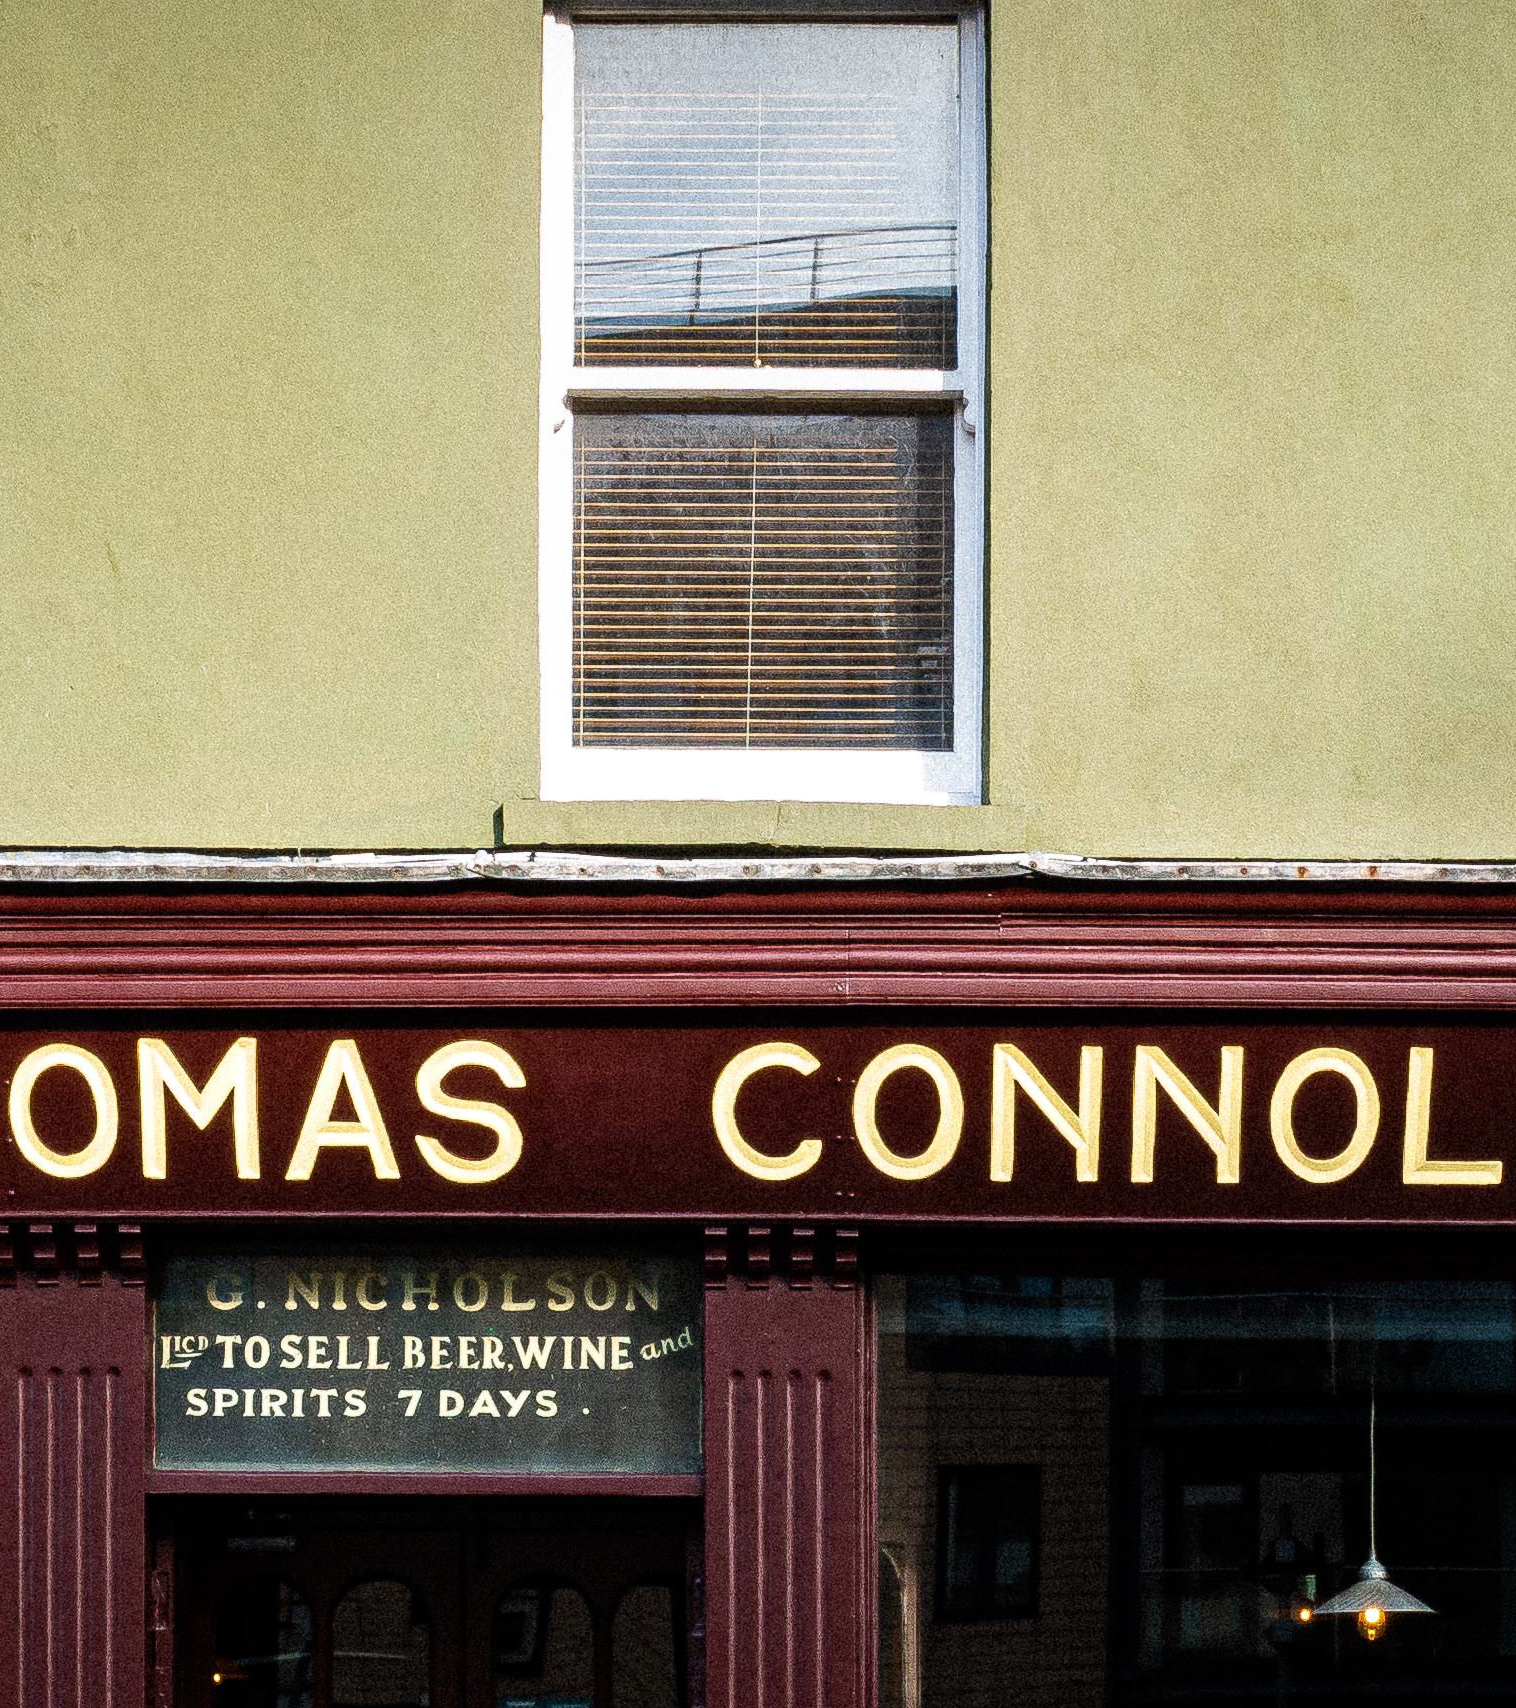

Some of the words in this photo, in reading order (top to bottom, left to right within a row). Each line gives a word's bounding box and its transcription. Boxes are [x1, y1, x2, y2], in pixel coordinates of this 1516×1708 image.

[284, 1270, 660, 1312] NICHOLSON
[215, 1335, 271, 1370] TO
[280, 1334, 390, 1370] SELL
[640, 1326, 694, 1361] and
[186, 1388, 368, 1418] SPIRITS
[397, 1390, 424, 1418] 7
[438, 1389, 559, 1418] DAYS
